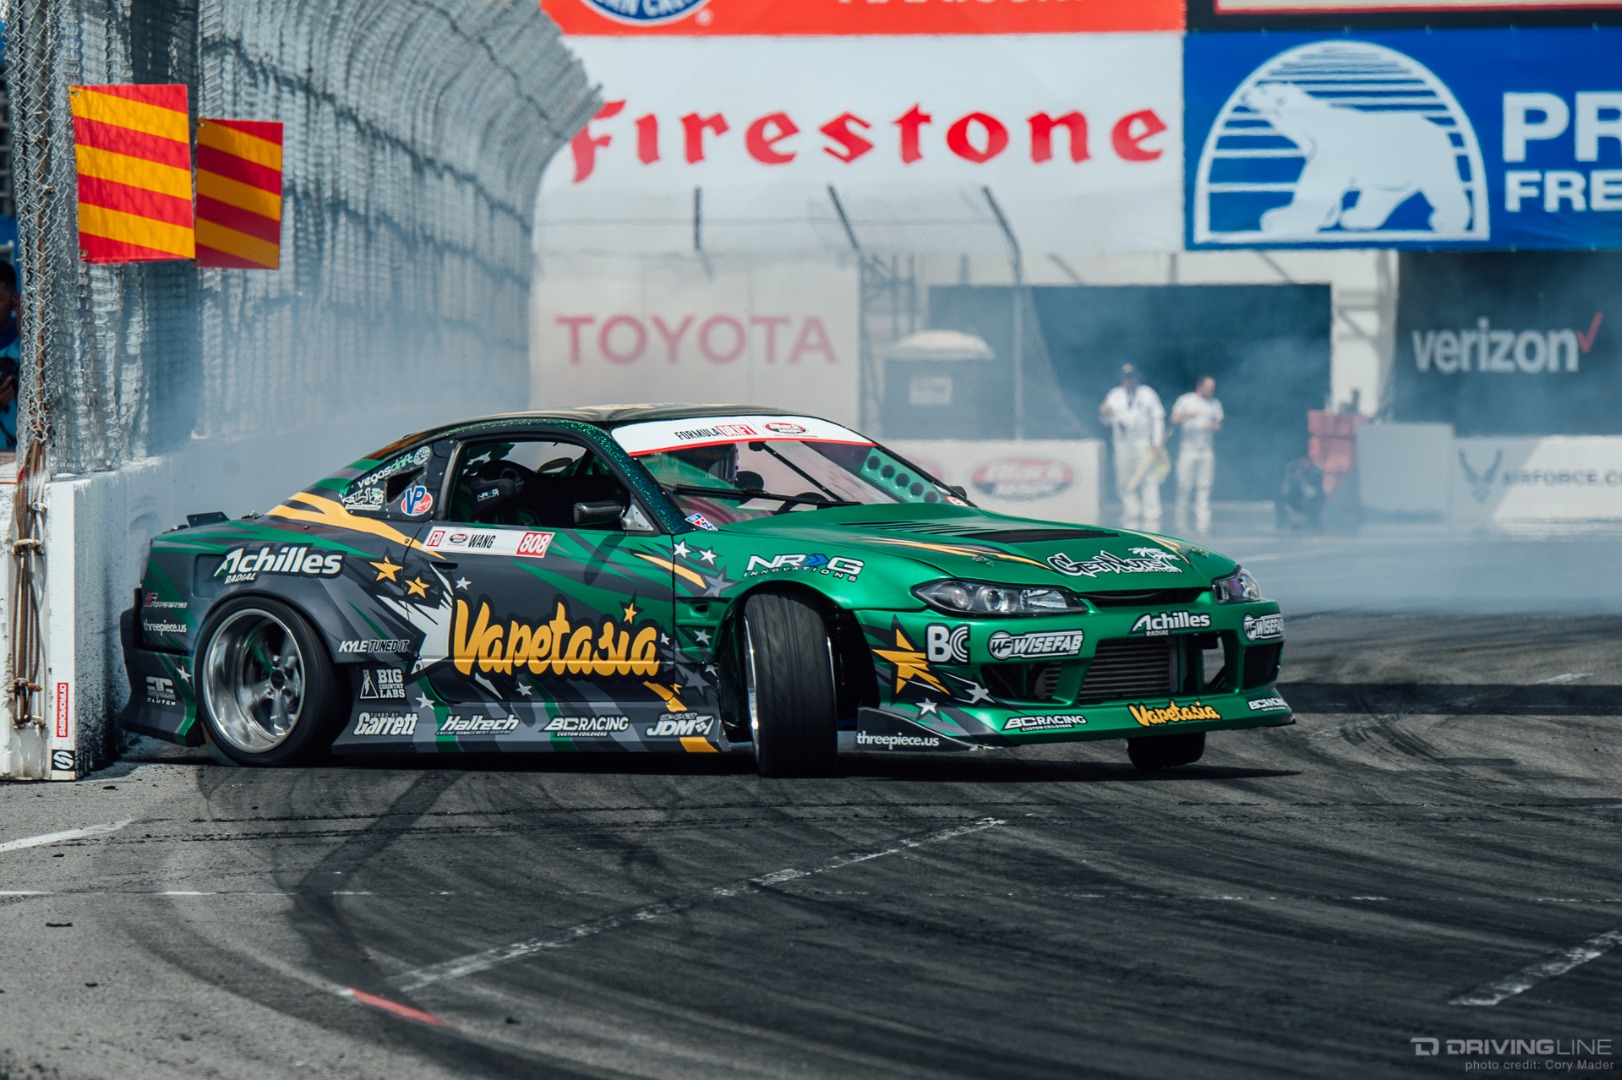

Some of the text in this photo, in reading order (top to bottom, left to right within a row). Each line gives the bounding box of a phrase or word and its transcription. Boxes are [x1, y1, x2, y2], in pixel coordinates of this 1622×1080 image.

[572, 99, 1168, 183] Firestone
[1505, 171, 1622, 212] FRE
[555, 315, 838, 365] TOYOTA
[1412, 316, 1579, 374] verizon
[674, 427, 722, 441] FORMULA
[406, 486, 426, 515] VP
[467, 534, 496, 549] WANG
[519, 533, 551, 554] 808
[214, 547, 343, 577] Achilles
[224, 572, 257, 585] RADIAL
[743, 566, 858, 582] INNOVATIONS
[143, 619, 188, 636] threepiece.us
[1132, 611, 1211, 632] Achilles
[338, 640, 368, 653] KYLE
[453, 599, 660, 677] Vapetasia
[927, 625, 968, 663] BC
[1013, 634, 1084, 654] WISEFAB
[376, 668, 403, 684] BIG
[379, 689, 406, 699] LABS
[353, 712, 419, 735] Garrett
[440, 714, 520, 731] Haltech
[1128, 700, 1222, 727] Vapetasia
[646, 719, 696, 736] JDM
[856, 731, 940, 750] threepiece.us
